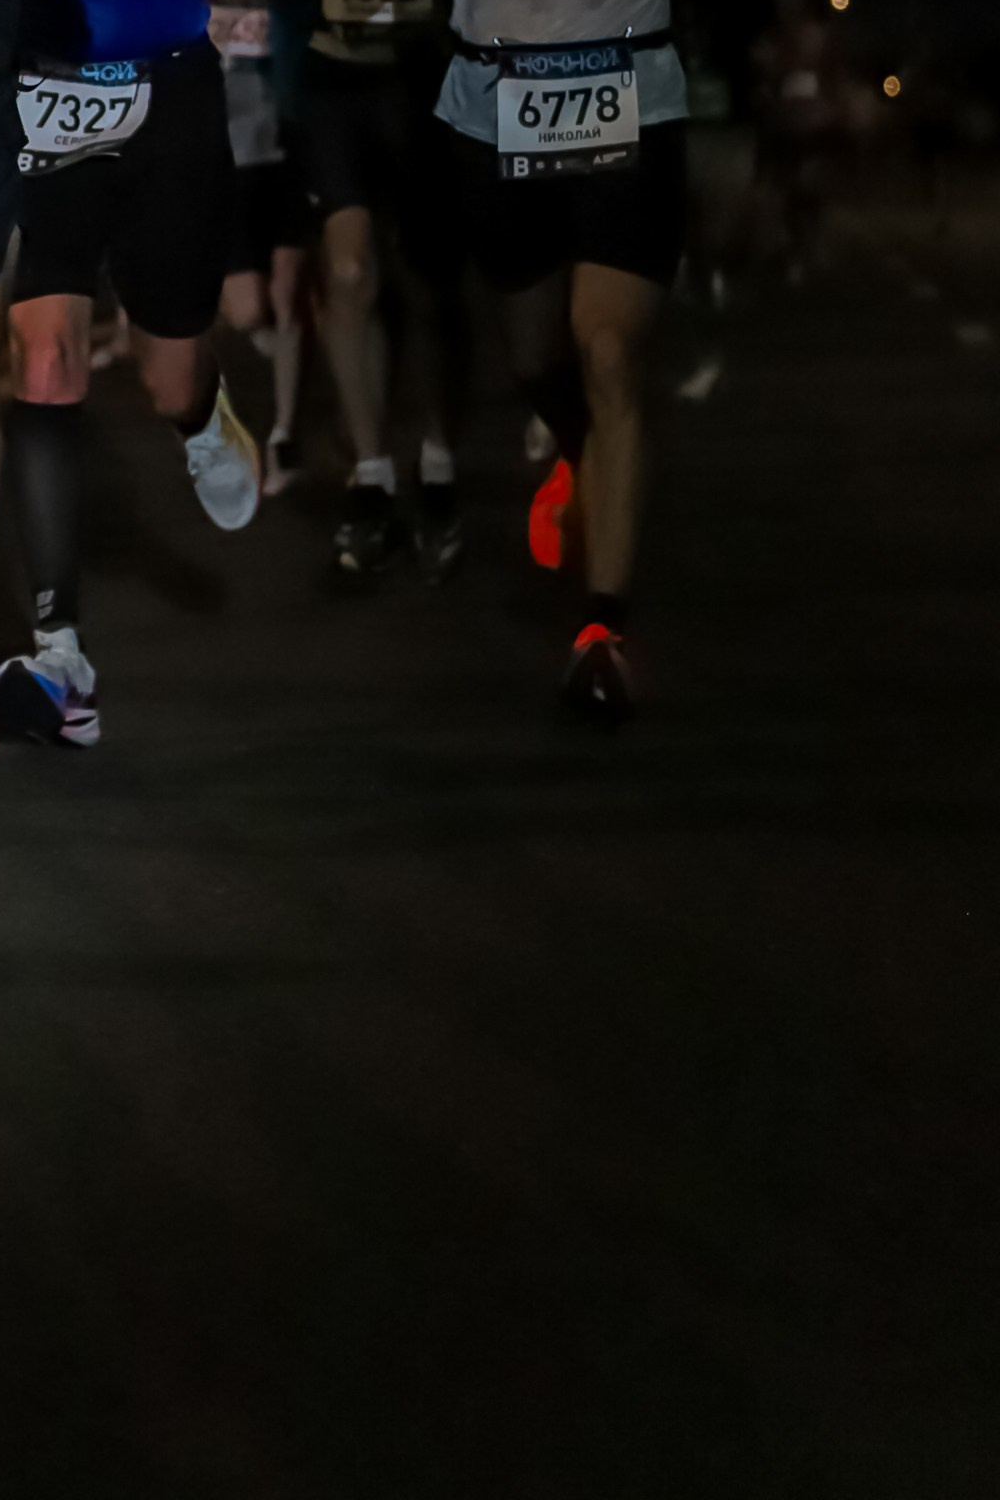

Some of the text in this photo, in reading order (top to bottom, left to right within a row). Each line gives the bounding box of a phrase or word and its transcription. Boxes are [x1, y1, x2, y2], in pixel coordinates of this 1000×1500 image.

[36, 90, 133, 133] 7327
[518, 85, 620, 128] 6778
[538, 127, 602, 143] НИКОЛАЙ
